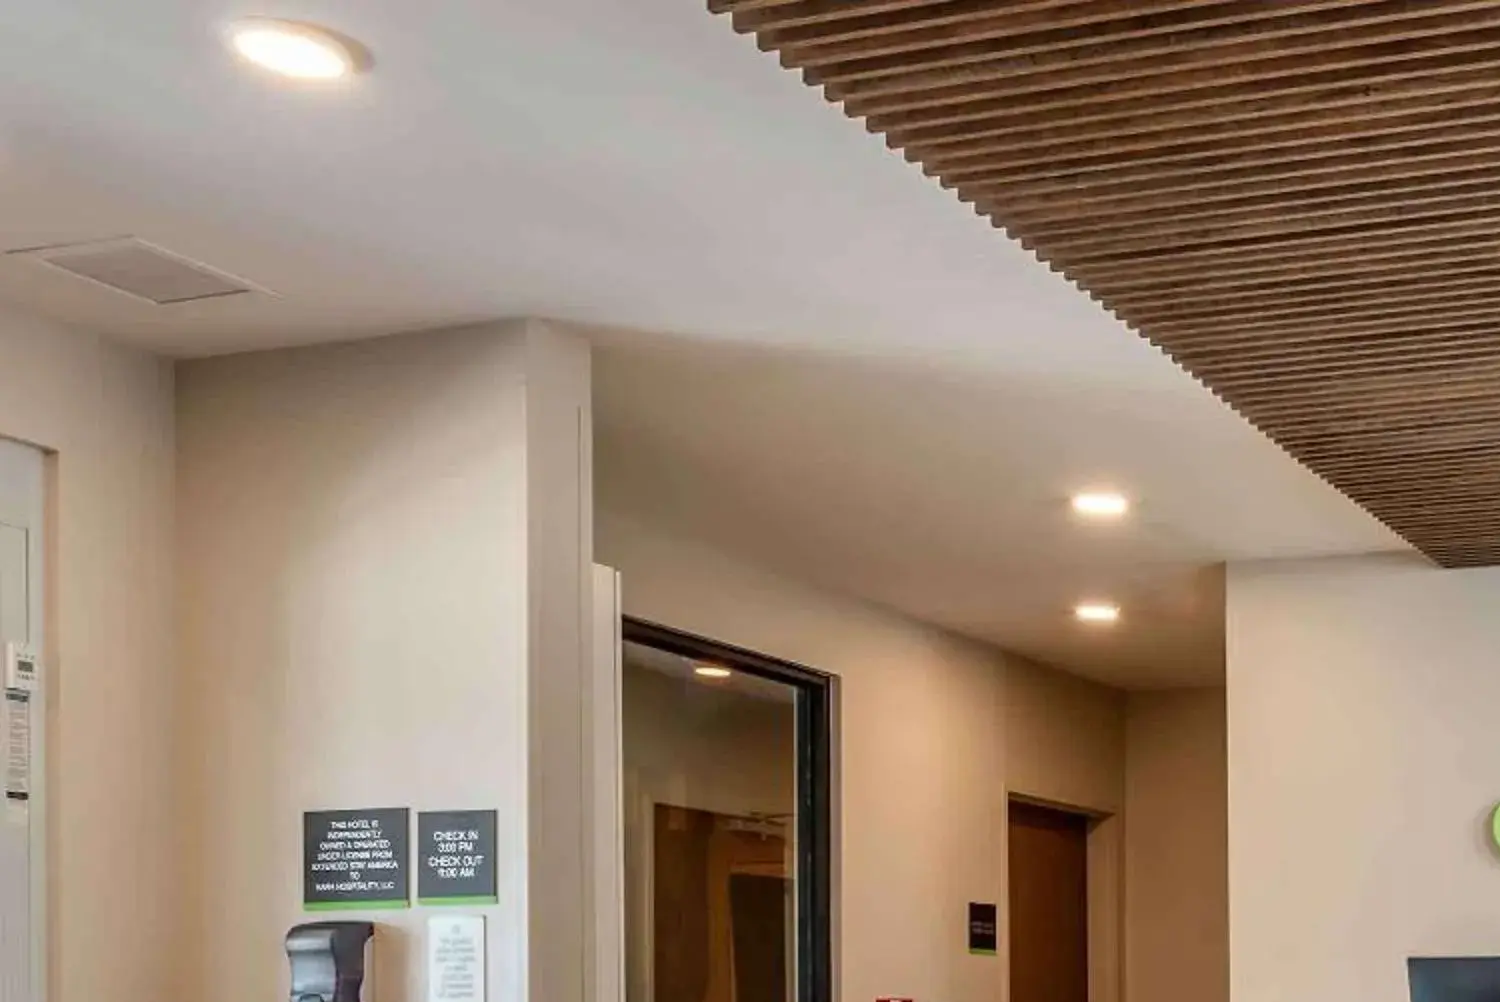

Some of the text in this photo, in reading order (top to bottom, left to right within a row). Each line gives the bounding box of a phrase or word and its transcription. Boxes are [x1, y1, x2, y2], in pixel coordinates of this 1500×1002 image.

[433, 830, 479, 841] CHECK IN
[438, 841, 473, 852] 3:00 PM
[427, 855, 485, 867] CHECK OUT
[349, 871, 360, 880] TO
[459, 867, 475, 877] AM
